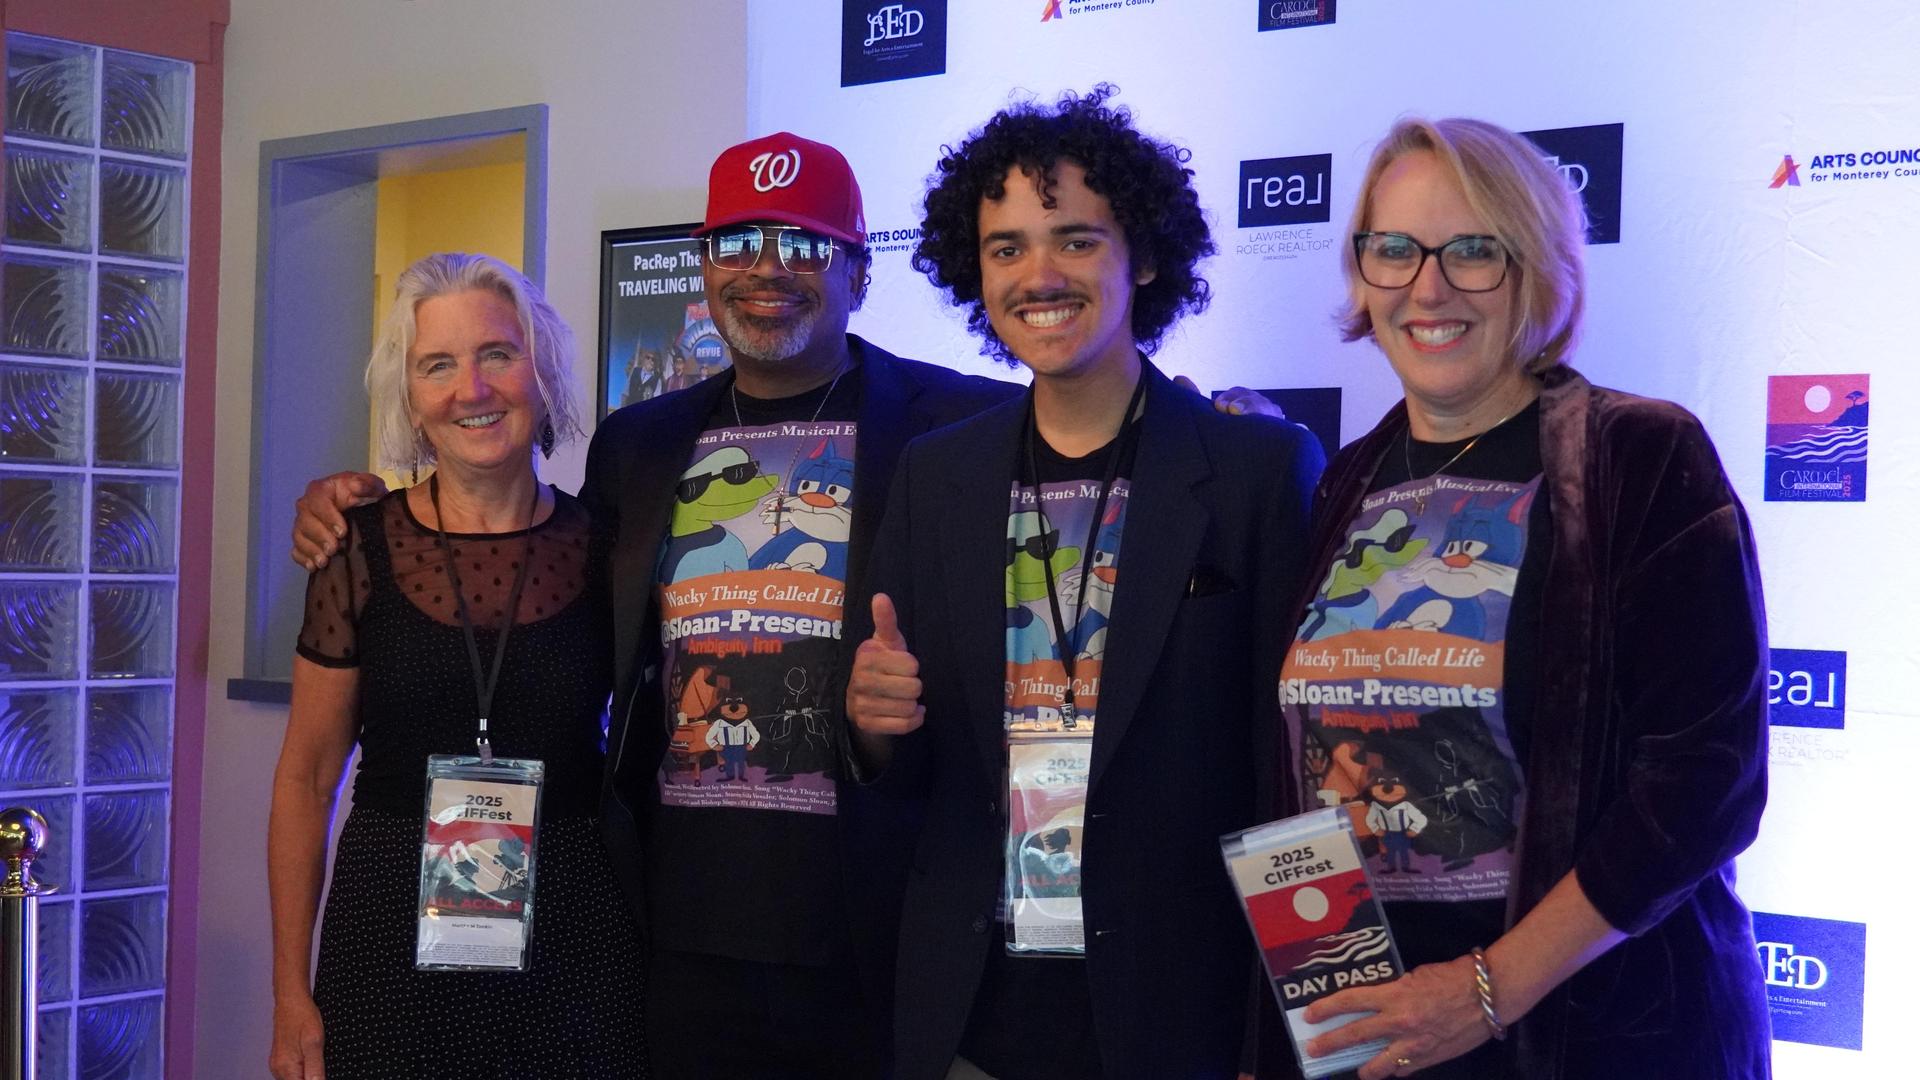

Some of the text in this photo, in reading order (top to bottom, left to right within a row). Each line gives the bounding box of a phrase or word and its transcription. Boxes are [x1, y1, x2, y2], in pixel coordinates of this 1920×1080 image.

[1069, 7, 1081, 15] for
[1084, 1, 1123, 13] Monterey
[1810, 153, 1857, 169] ARTS
[750, 149, 800, 192] W
[1811, 167, 1920, 182] for Monterey Cou
[1247, 172, 1323, 210] real
[1249, 228, 1313, 243] LAWRENCE
[875, 244, 910, 253] Monterey
[1236, 243, 1275, 255] ROECK
[633, 253, 677, 273] PacRep
[618, 277, 687, 297] TRAVELING
[696, 346, 721, 358] REVUE
[721, 428, 778, 442] Presents
[781, 424, 840, 437] Musical
[844, 425, 857, 436] E
[1020, 488, 1076, 504] Prsents
[1386, 485, 1433, 504] Presents
[1434, 478, 1492, 493] Musical
[1780, 489, 1841, 498] FILM FESTIVAL
[665, 587, 707, 608] Wacky
[711, 584, 758, 604] Thing
[763, 584, 818, 602] Called
[688, 636, 784, 659] Ambiguity Inn
[1294, 646, 1486, 673] Wacky Thing Called Life
[1020, 676, 1066, 702] Thing
[1278, 678, 1497, 712] @Sloan-Presents
[1047, 758, 1086, 770] 2025
[799, 787, 820, 797] Thing
[466, 794, 503, 807] 2025
[780, 802, 812, 812] Reserved
[458, 807, 512, 821] IFFest
[1270, 846, 1315, 869] 2025
[1264, 858, 1335, 886] CIFFest
[1283, 961, 1394, 1000] DAY PASS
[1779, 995, 1827, 1008] Entertainment
